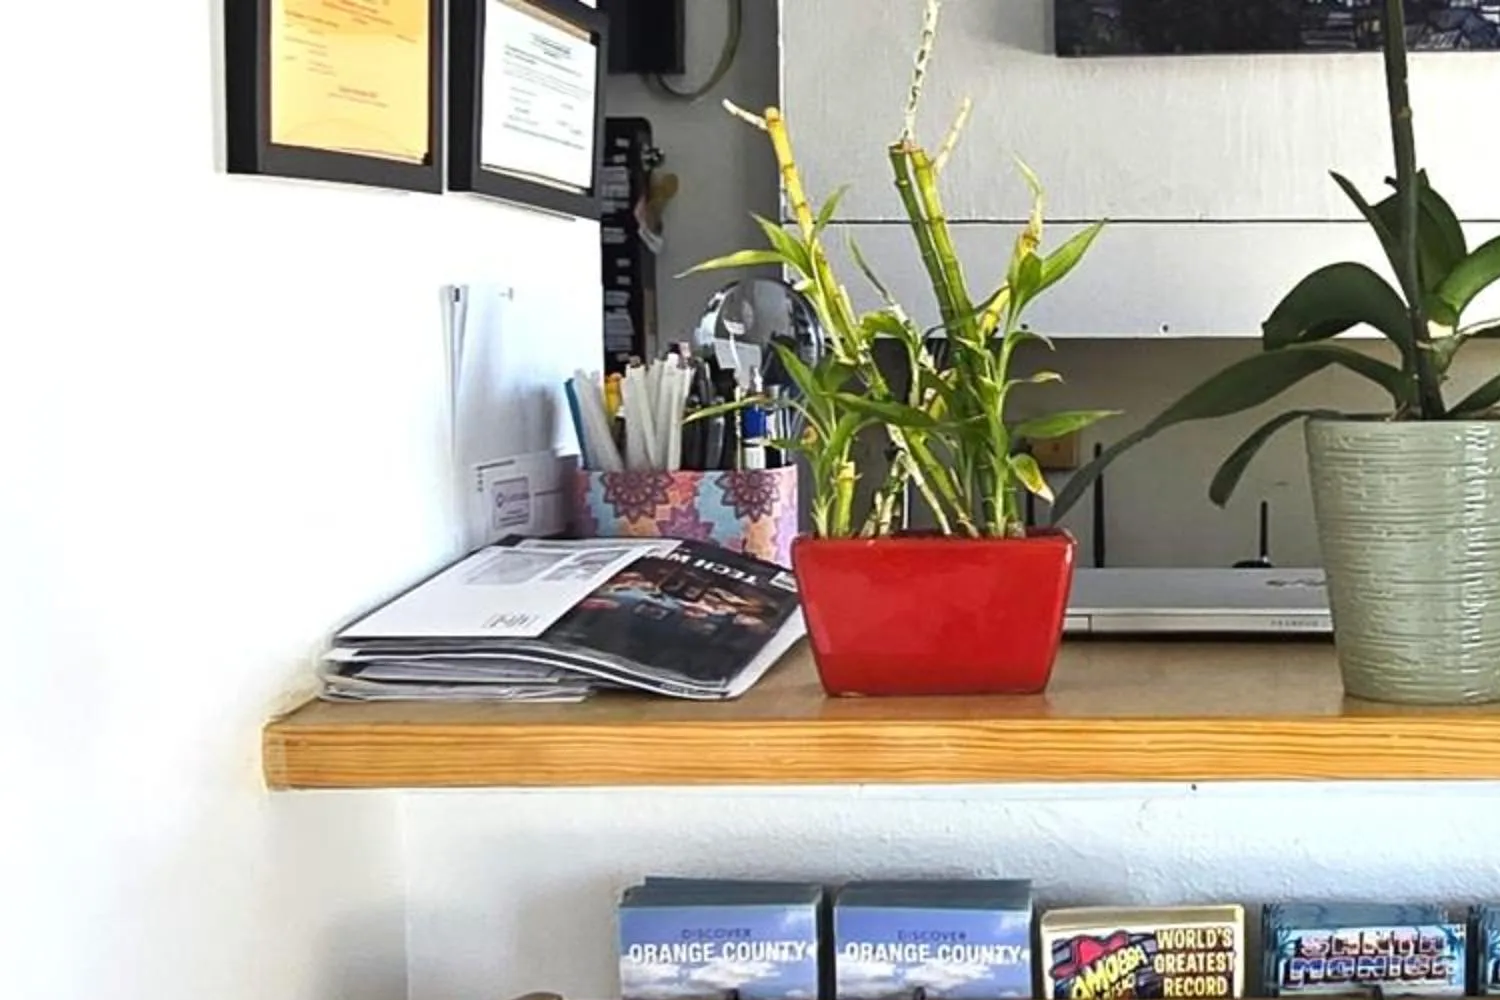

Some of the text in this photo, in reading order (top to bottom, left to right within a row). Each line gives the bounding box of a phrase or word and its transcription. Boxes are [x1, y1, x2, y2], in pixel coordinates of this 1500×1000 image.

[681, 928, 751, 938] DISCOVER
[1155, 928, 1233, 949] WORLD'S
[629, 941, 806, 964] ORANGE COUNTY
[1154, 952, 1235, 973] GREATEST
[1163, 976, 1228, 997] RECORD
